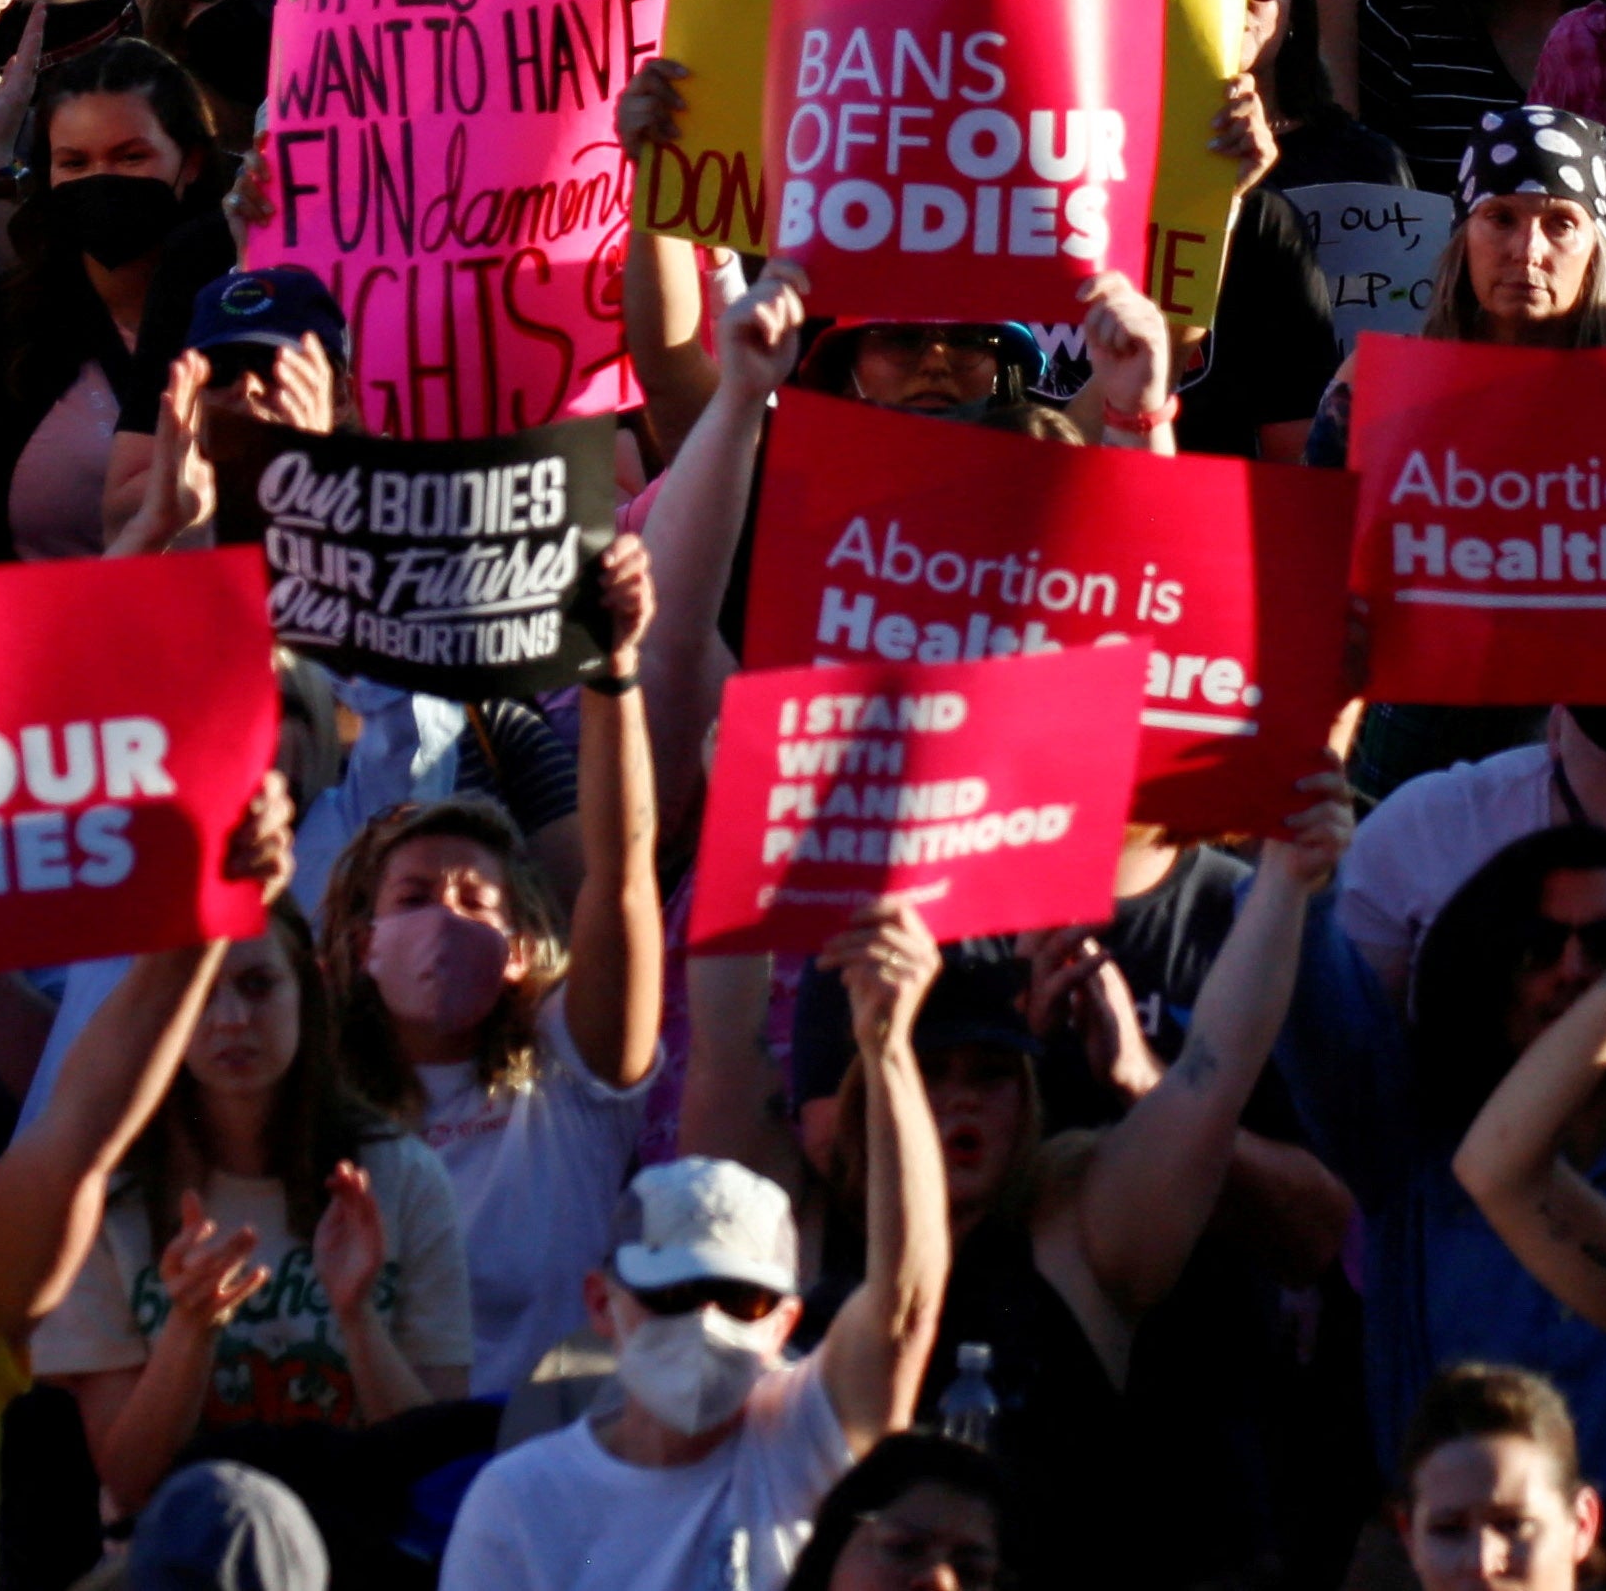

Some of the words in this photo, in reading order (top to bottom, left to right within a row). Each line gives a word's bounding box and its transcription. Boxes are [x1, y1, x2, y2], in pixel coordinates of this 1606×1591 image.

[273, 19, 412, 120] WANT
[423, 15, 486, 115] TO
[798, 27, 1004, 101] BANS
[788, 104, 931, 173] OFF
[948, 109, 1125, 182] OUR
[779, 187, 1107, 259] BODIES
[258, 451, 363, 534] Our
[370, 455, 567, 538] BODIES
[265, 526, 376, 600] OUR
[380, 524, 582, 616] Futures
[827, 516, 1118, 616] Abortion
[1136, 563, 1184, 625] is
[267, 575, 351, 637] Our
[355, 609, 561, 667] ABORTIONS
[817, 586, 1062, 665] Health
[778, 698, 800, 738] I
[806, 692, 967, 735] STAND
[777, 740, 903, 778] WITH
[762, 803, 1075, 866] PARENTHOOD
[767, 776, 988, 822] PLANNED
